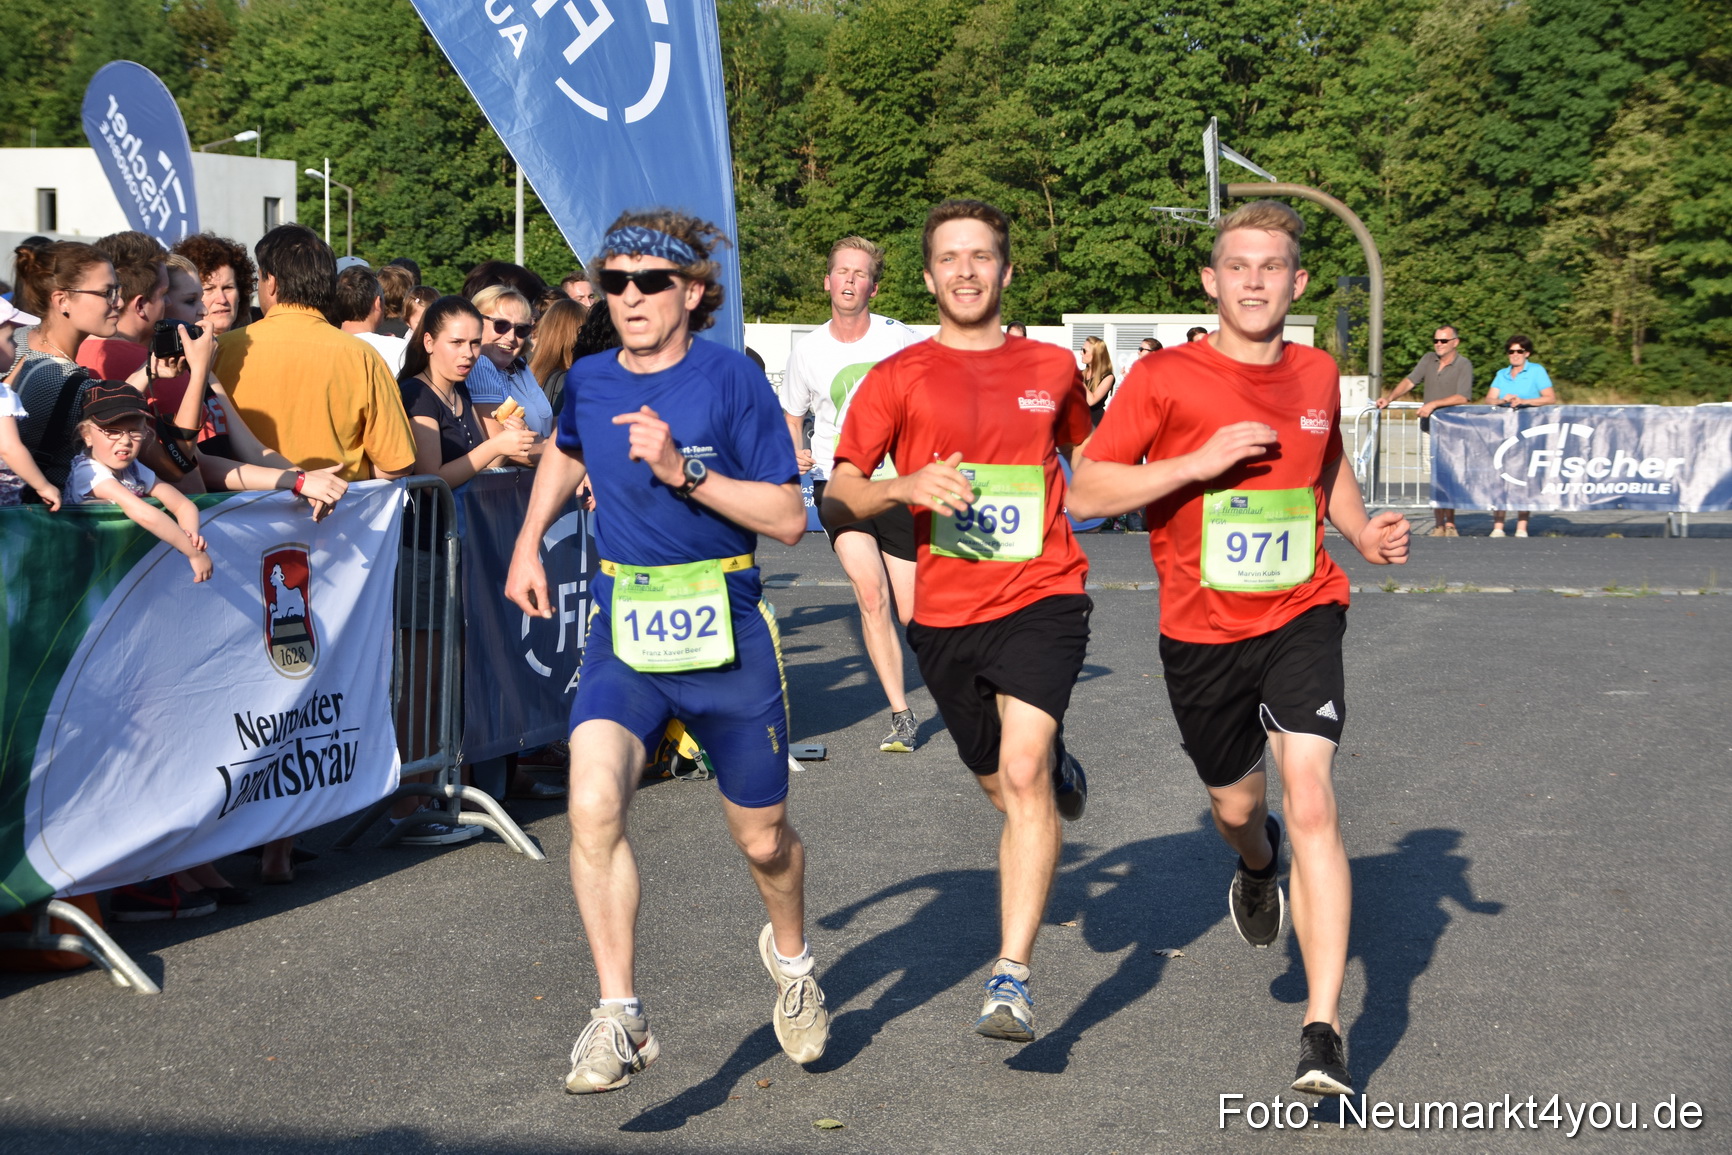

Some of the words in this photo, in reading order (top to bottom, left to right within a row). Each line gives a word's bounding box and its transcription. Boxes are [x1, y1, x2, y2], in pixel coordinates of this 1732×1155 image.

[168, 443, 189, 467] SONY
[1528, 449, 1685, 479] Fischer
[1541, 482, 1671, 496] AUTOMOBILE
[955, 503, 1020, 534] 969
[1222, 507, 1263, 515] firmenlauf
[1226, 530, 1289, 563] 971
[624, 605, 718, 642] 1492
[281, 645, 307, 667] 1628
[1315, 709, 1339, 721] adidas
